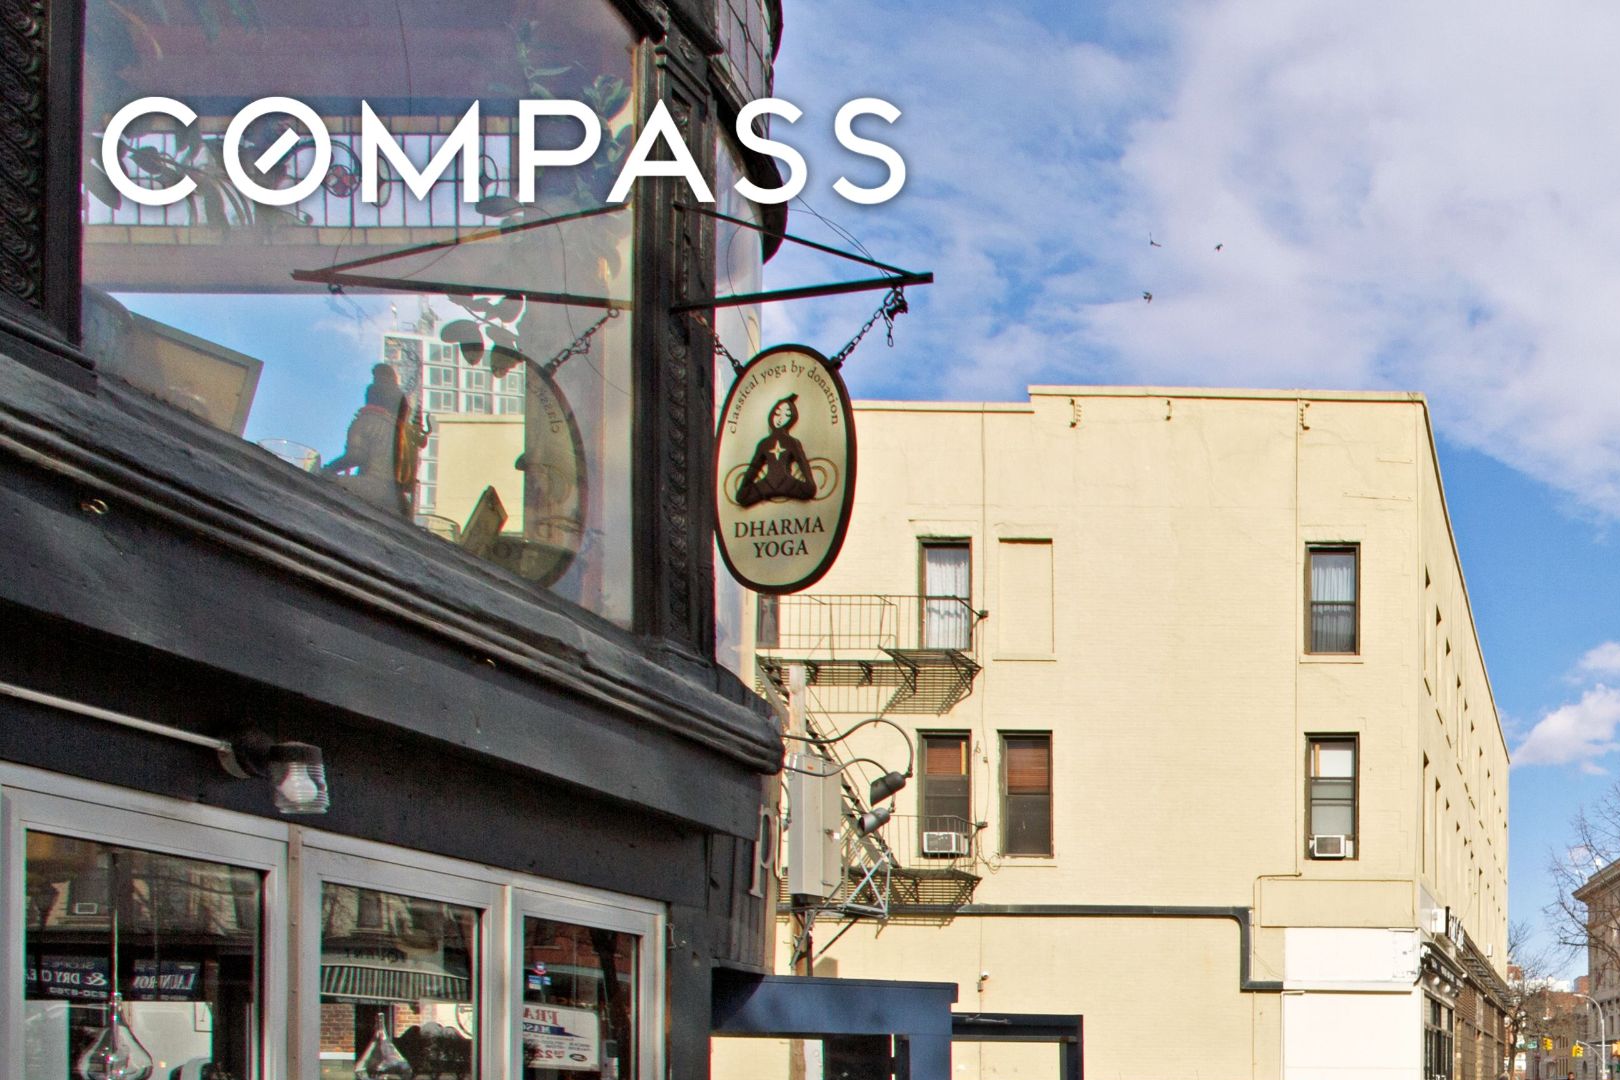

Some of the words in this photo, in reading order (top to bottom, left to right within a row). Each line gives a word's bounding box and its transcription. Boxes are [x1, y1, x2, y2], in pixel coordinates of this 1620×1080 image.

[728, 375, 759, 434] classical
[760, 363, 787, 383] yoga
[790, 360, 805, 378] by
[807, 366, 839, 425] donation
[734, 516, 825, 538] DHARMA
[753, 539, 809, 558] YOGA
